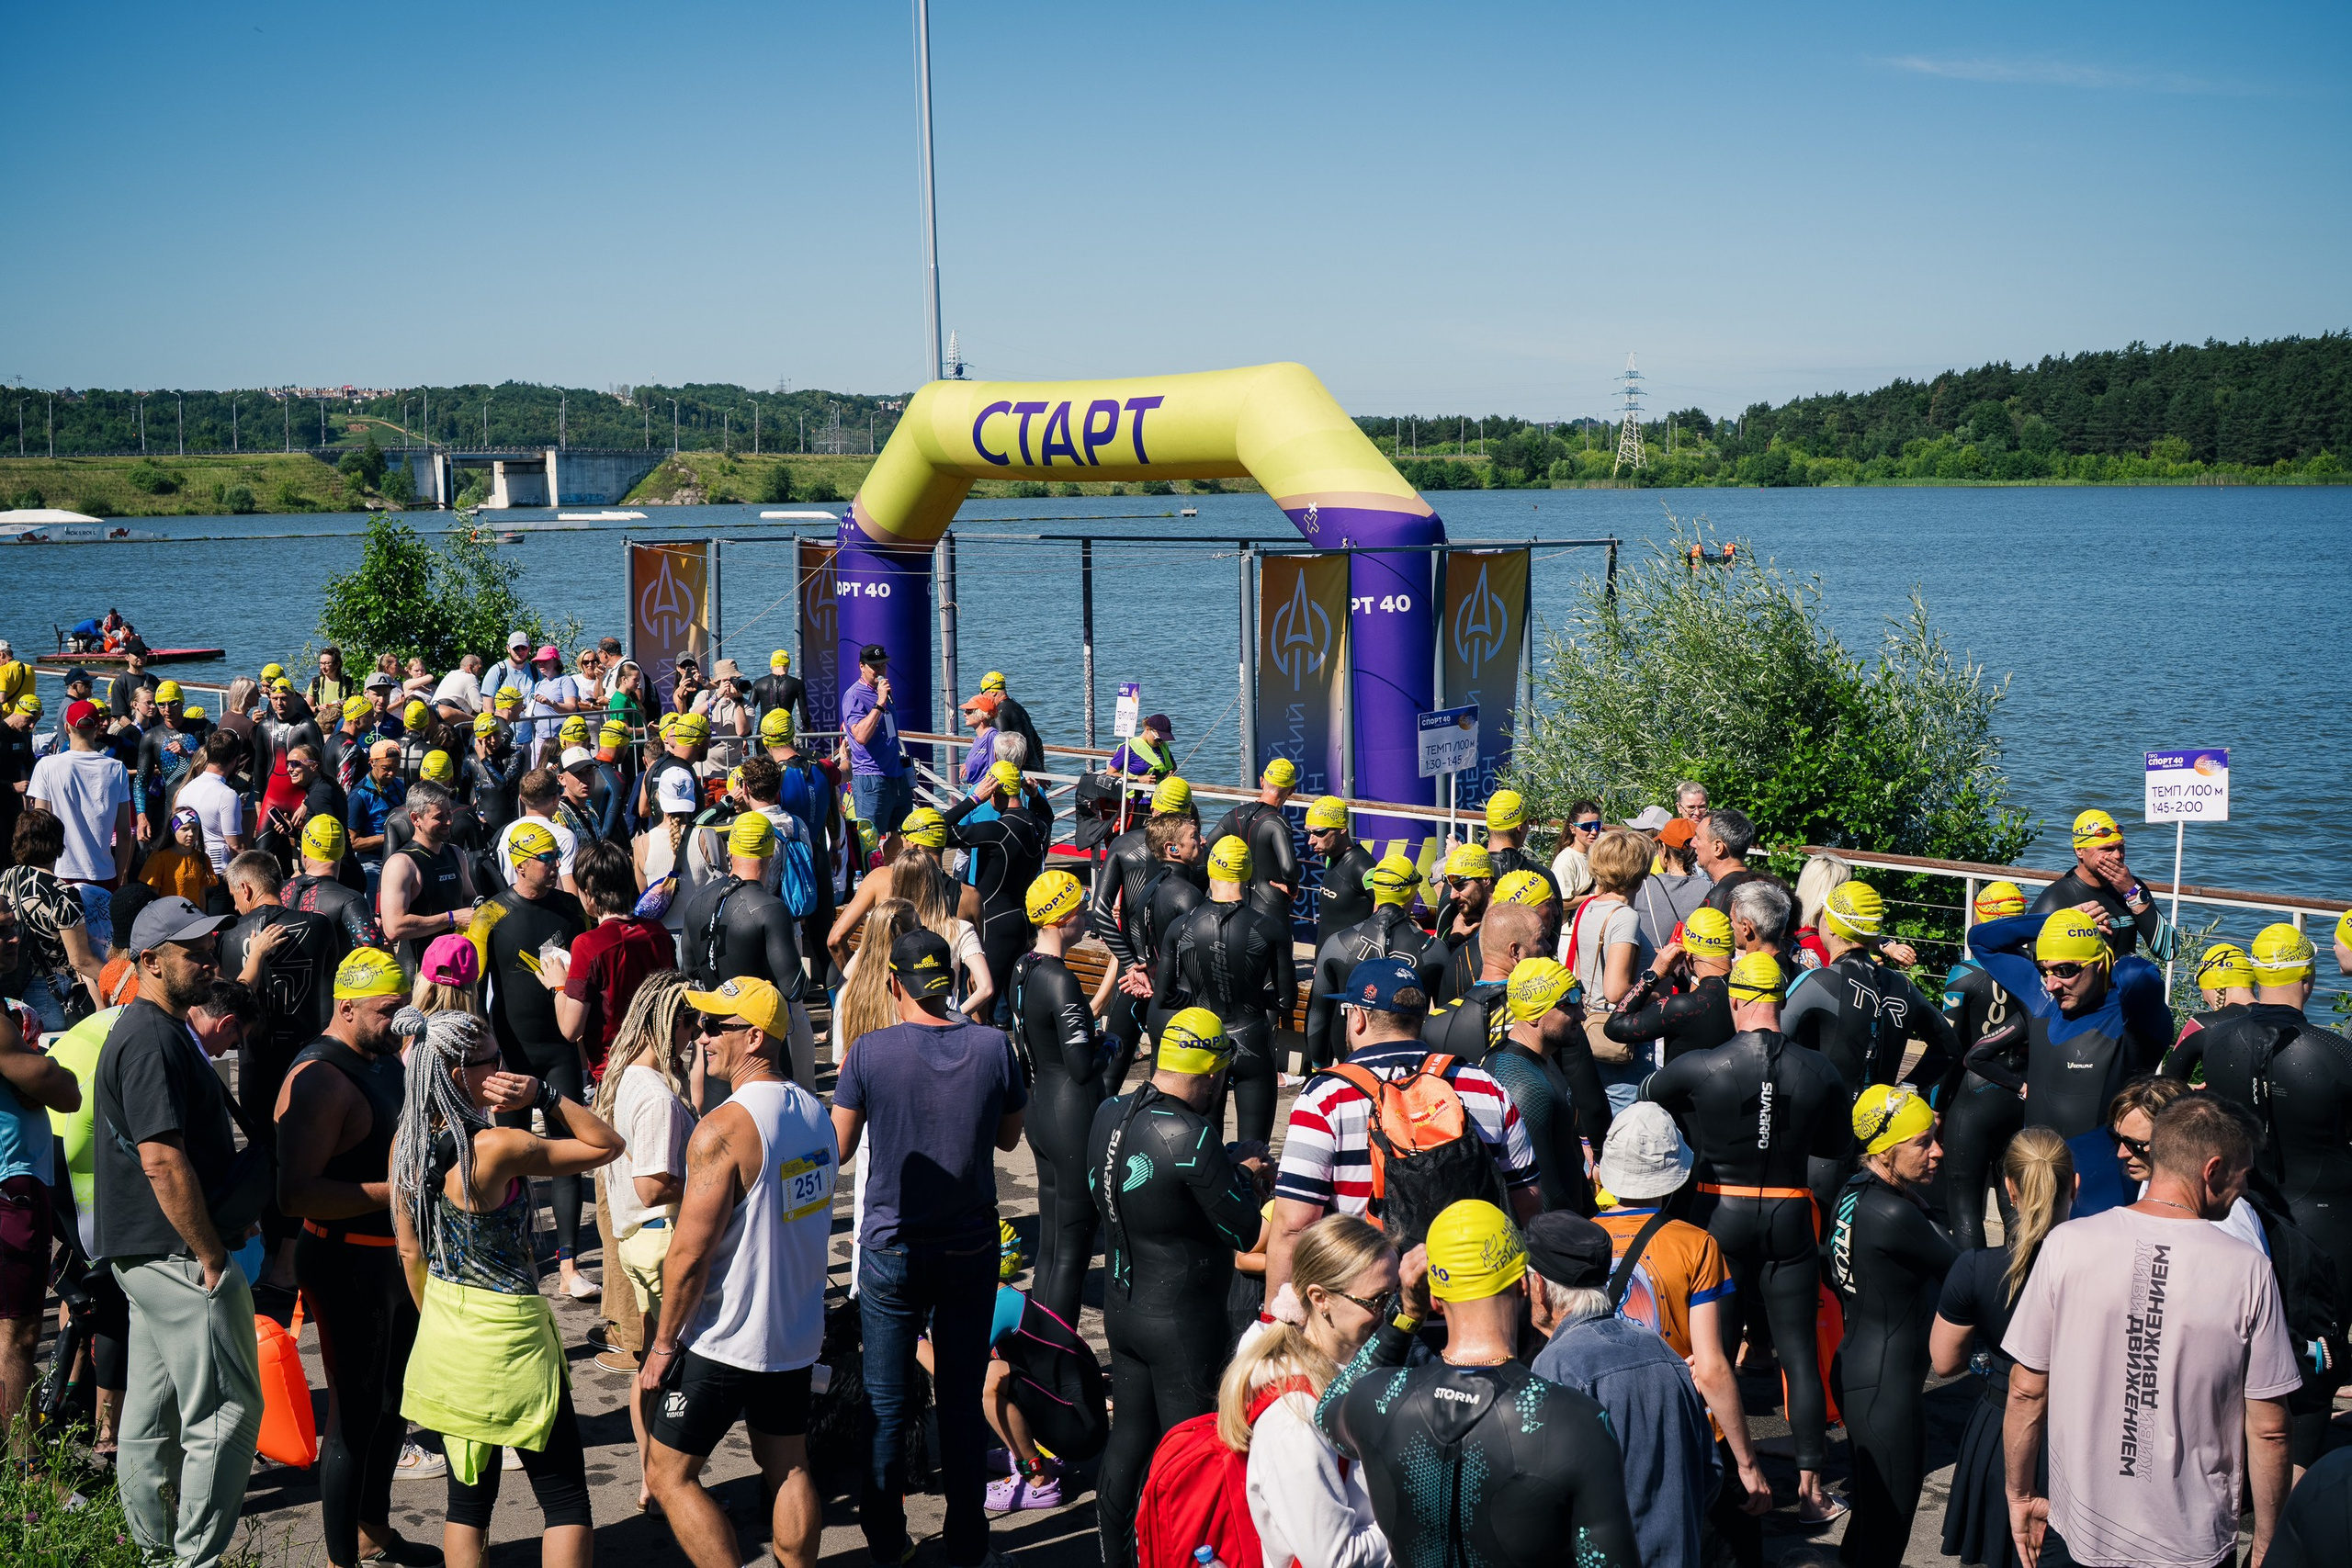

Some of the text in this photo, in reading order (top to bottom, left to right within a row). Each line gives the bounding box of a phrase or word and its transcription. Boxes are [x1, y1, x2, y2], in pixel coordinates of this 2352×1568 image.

[972, 395, 1165, 467] СТАРТ
[865, 582, 891, 598] 40
[1379, 594, 1411, 614] 40
[1421, 717, 1442, 727] СПОРТ
[1442, 715, 1452, 723] 40
[1425, 742, 1452, 755] ТЕМП
[1453, 739, 1469, 752] /100
[2148, 758, 2173, 766] СПОРТ
[2152, 785, 2181, 797] ТЕМП
[2184, 784, 2212, 796] /100
[311, 839, 322, 848] 40
[759, 832, 775, 845] СПО
[1216, 859, 1228, 868] 40
[1319, 886, 1338, 899] rca
[1509, 876, 1540, 903] ОРТ 40
[1029, 903, 1041, 914] PRO
[1032, 882, 1076, 919] СПОРТ 40
[1705, 937, 1721, 945] 40
[2067, 928, 2098, 938] СПОР
[1849, 977, 1908, 1028] TYR
[795, 1170, 822, 1200] 251
[805, 1195, 817, 1203] Travel
[1430, 1264, 1449, 1281] 40
[2119, 1238, 2154, 1478] ЖИВИ ДВИЖЕНИЕМ
[2135, 1244, 2171, 1483] ЖИВИ ДВИЖЕНИЕМ
[1434, 1387, 1480, 1404] STORM
